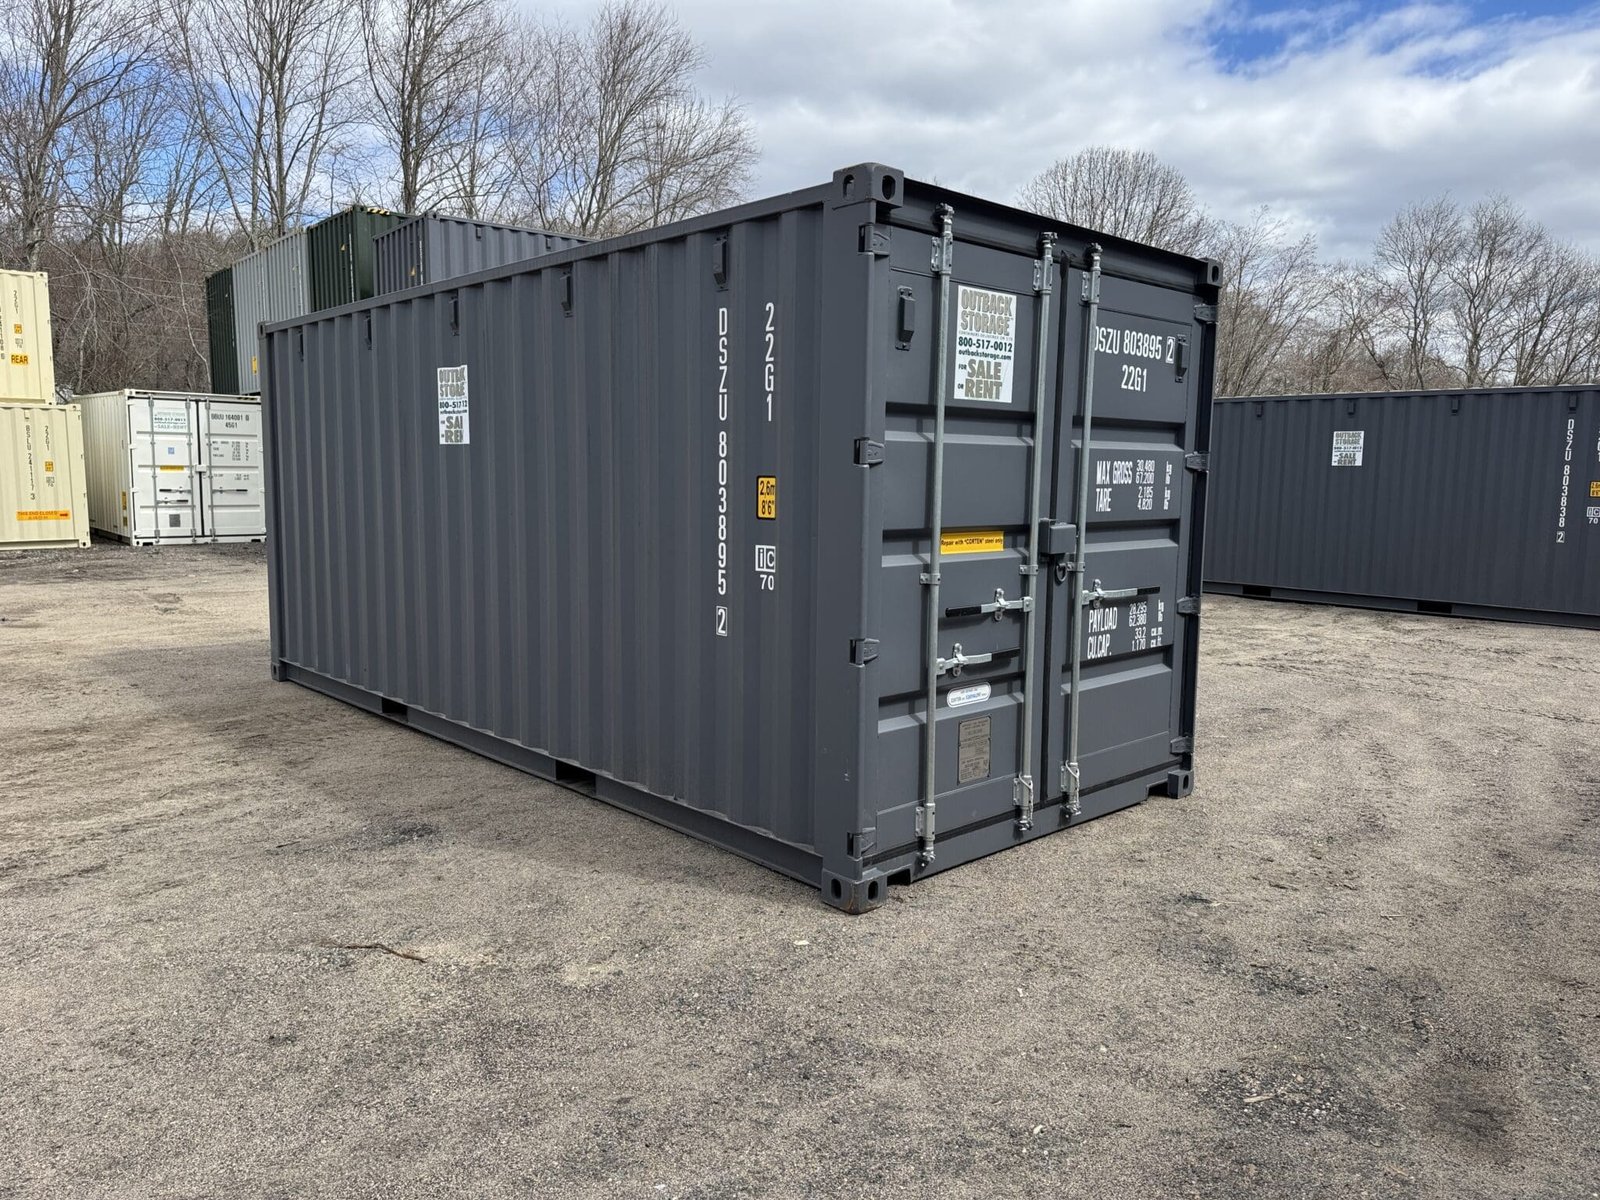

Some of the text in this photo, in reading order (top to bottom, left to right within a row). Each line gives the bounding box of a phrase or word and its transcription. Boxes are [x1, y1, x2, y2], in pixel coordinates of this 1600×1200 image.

[961, 289, 1012, 316] OUTBACK
[960, 310, 1011, 337] STORAGE
[958, 336, 1013, 353] 800-517-0012
[958, 350, 1012, 361] outbackstorage.com
[1123, 329, 1162, 360] 803895
[1166, 337, 1175, 363] 2
[11, 354, 28, 365] REAR
[765, 302, 775, 422] 22G1
[958, 358, 1002, 381] FOR SALE
[964, 378, 1003, 400] RENT
[1121, 364, 1147, 393] 22G1
[716, 307, 728, 635] DSZU 803895 2
[1096, 460, 1111, 485] MAX
[1112, 460, 1133, 485] GROSS
[1135, 471, 1155, 485] 67.200
[1556, 418, 1575, 543] DSZU 803838 2
[1095, 487, 1112, 512] TARE
[1137, 498, 1153, 510] 4.820
[1589, 517, 1599, 525] 70
[759, 573, 775, 591] 70
[1088, 606, 1118, 634] PAYLOAD
[1128, 613, 1147, 627] 62.380
[1134, 626, 1147, 640] 33.2
[1131, 638, 1147, 652] 1.170
